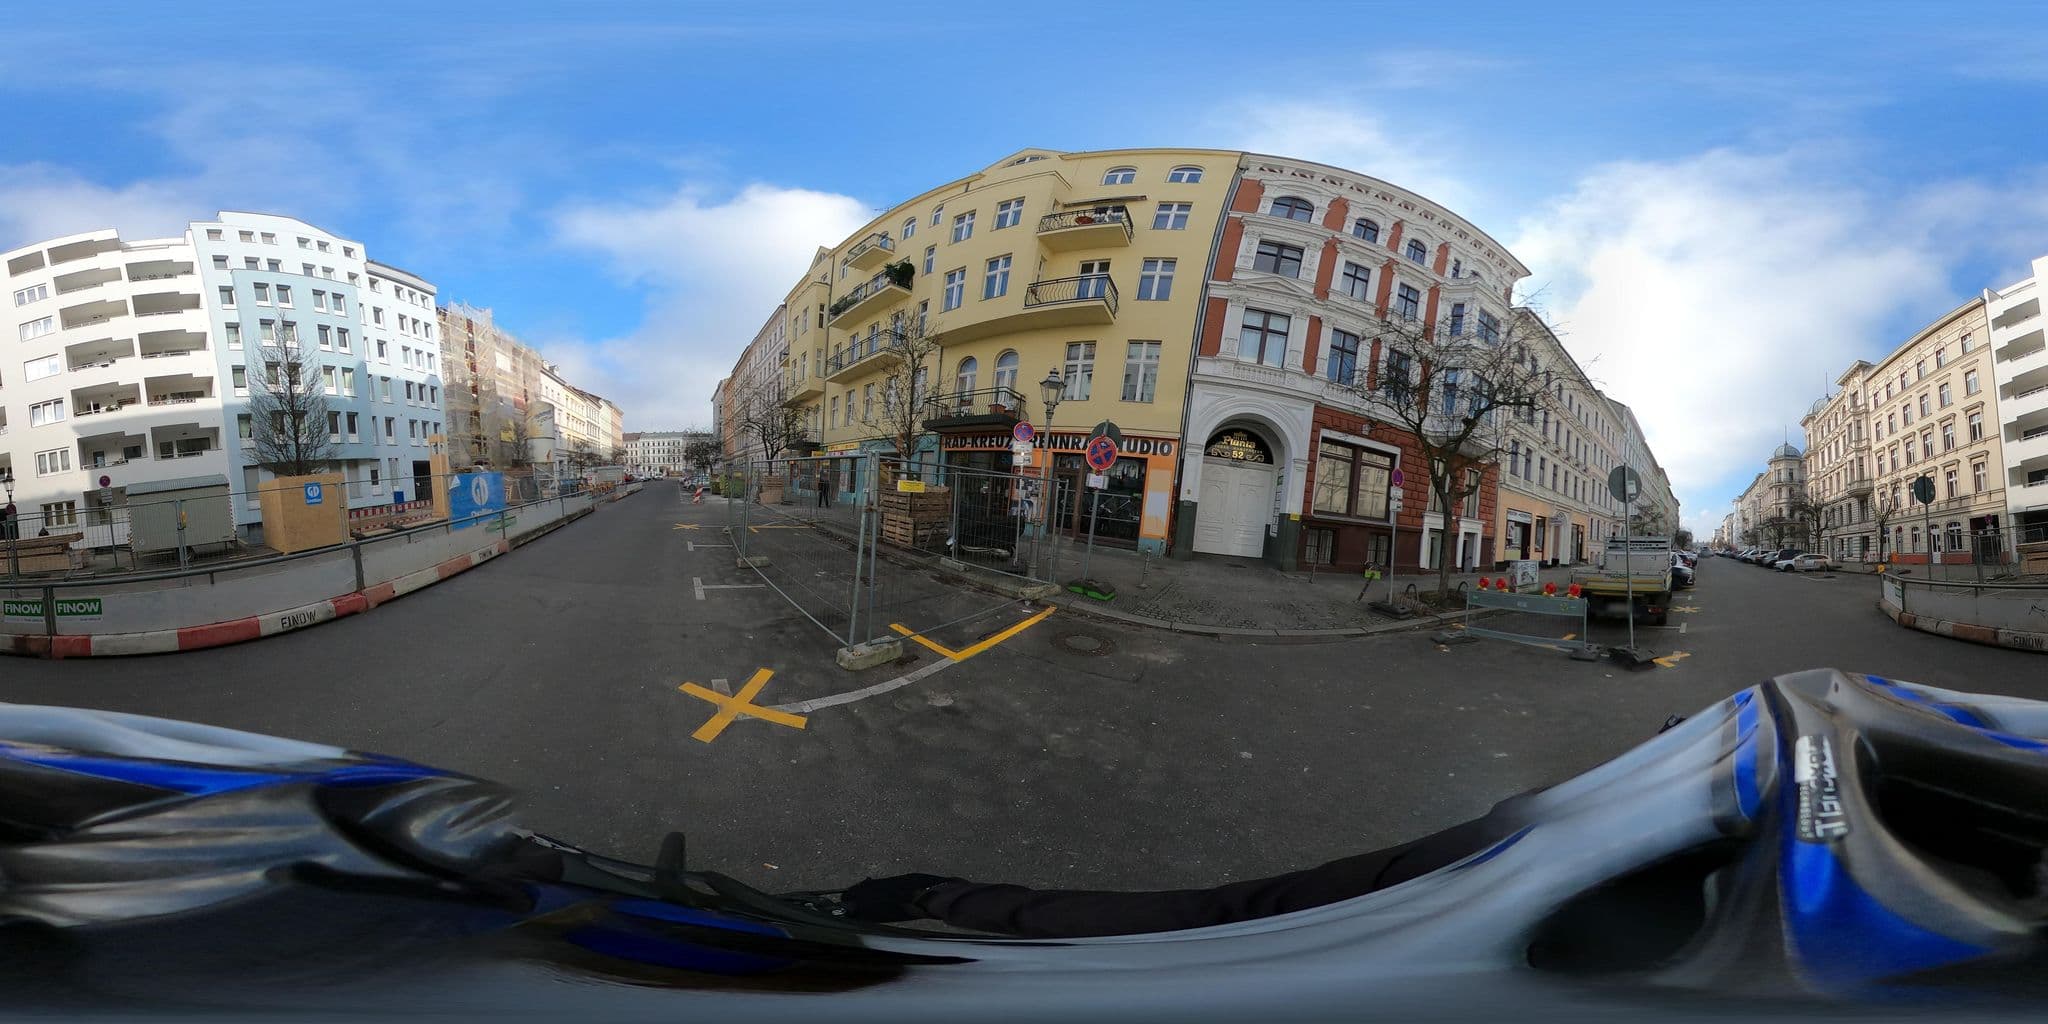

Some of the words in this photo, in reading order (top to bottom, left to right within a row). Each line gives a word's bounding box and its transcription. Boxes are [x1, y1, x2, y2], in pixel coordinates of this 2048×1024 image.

[1231, 450, 1245, 460] 52
[5, 603, 42, 614] FINOW
[56, 601, 99, 613] FINOW
[280, 609, 317, 629] FINOW
[2013, 635, 2044, 649] FINOW
